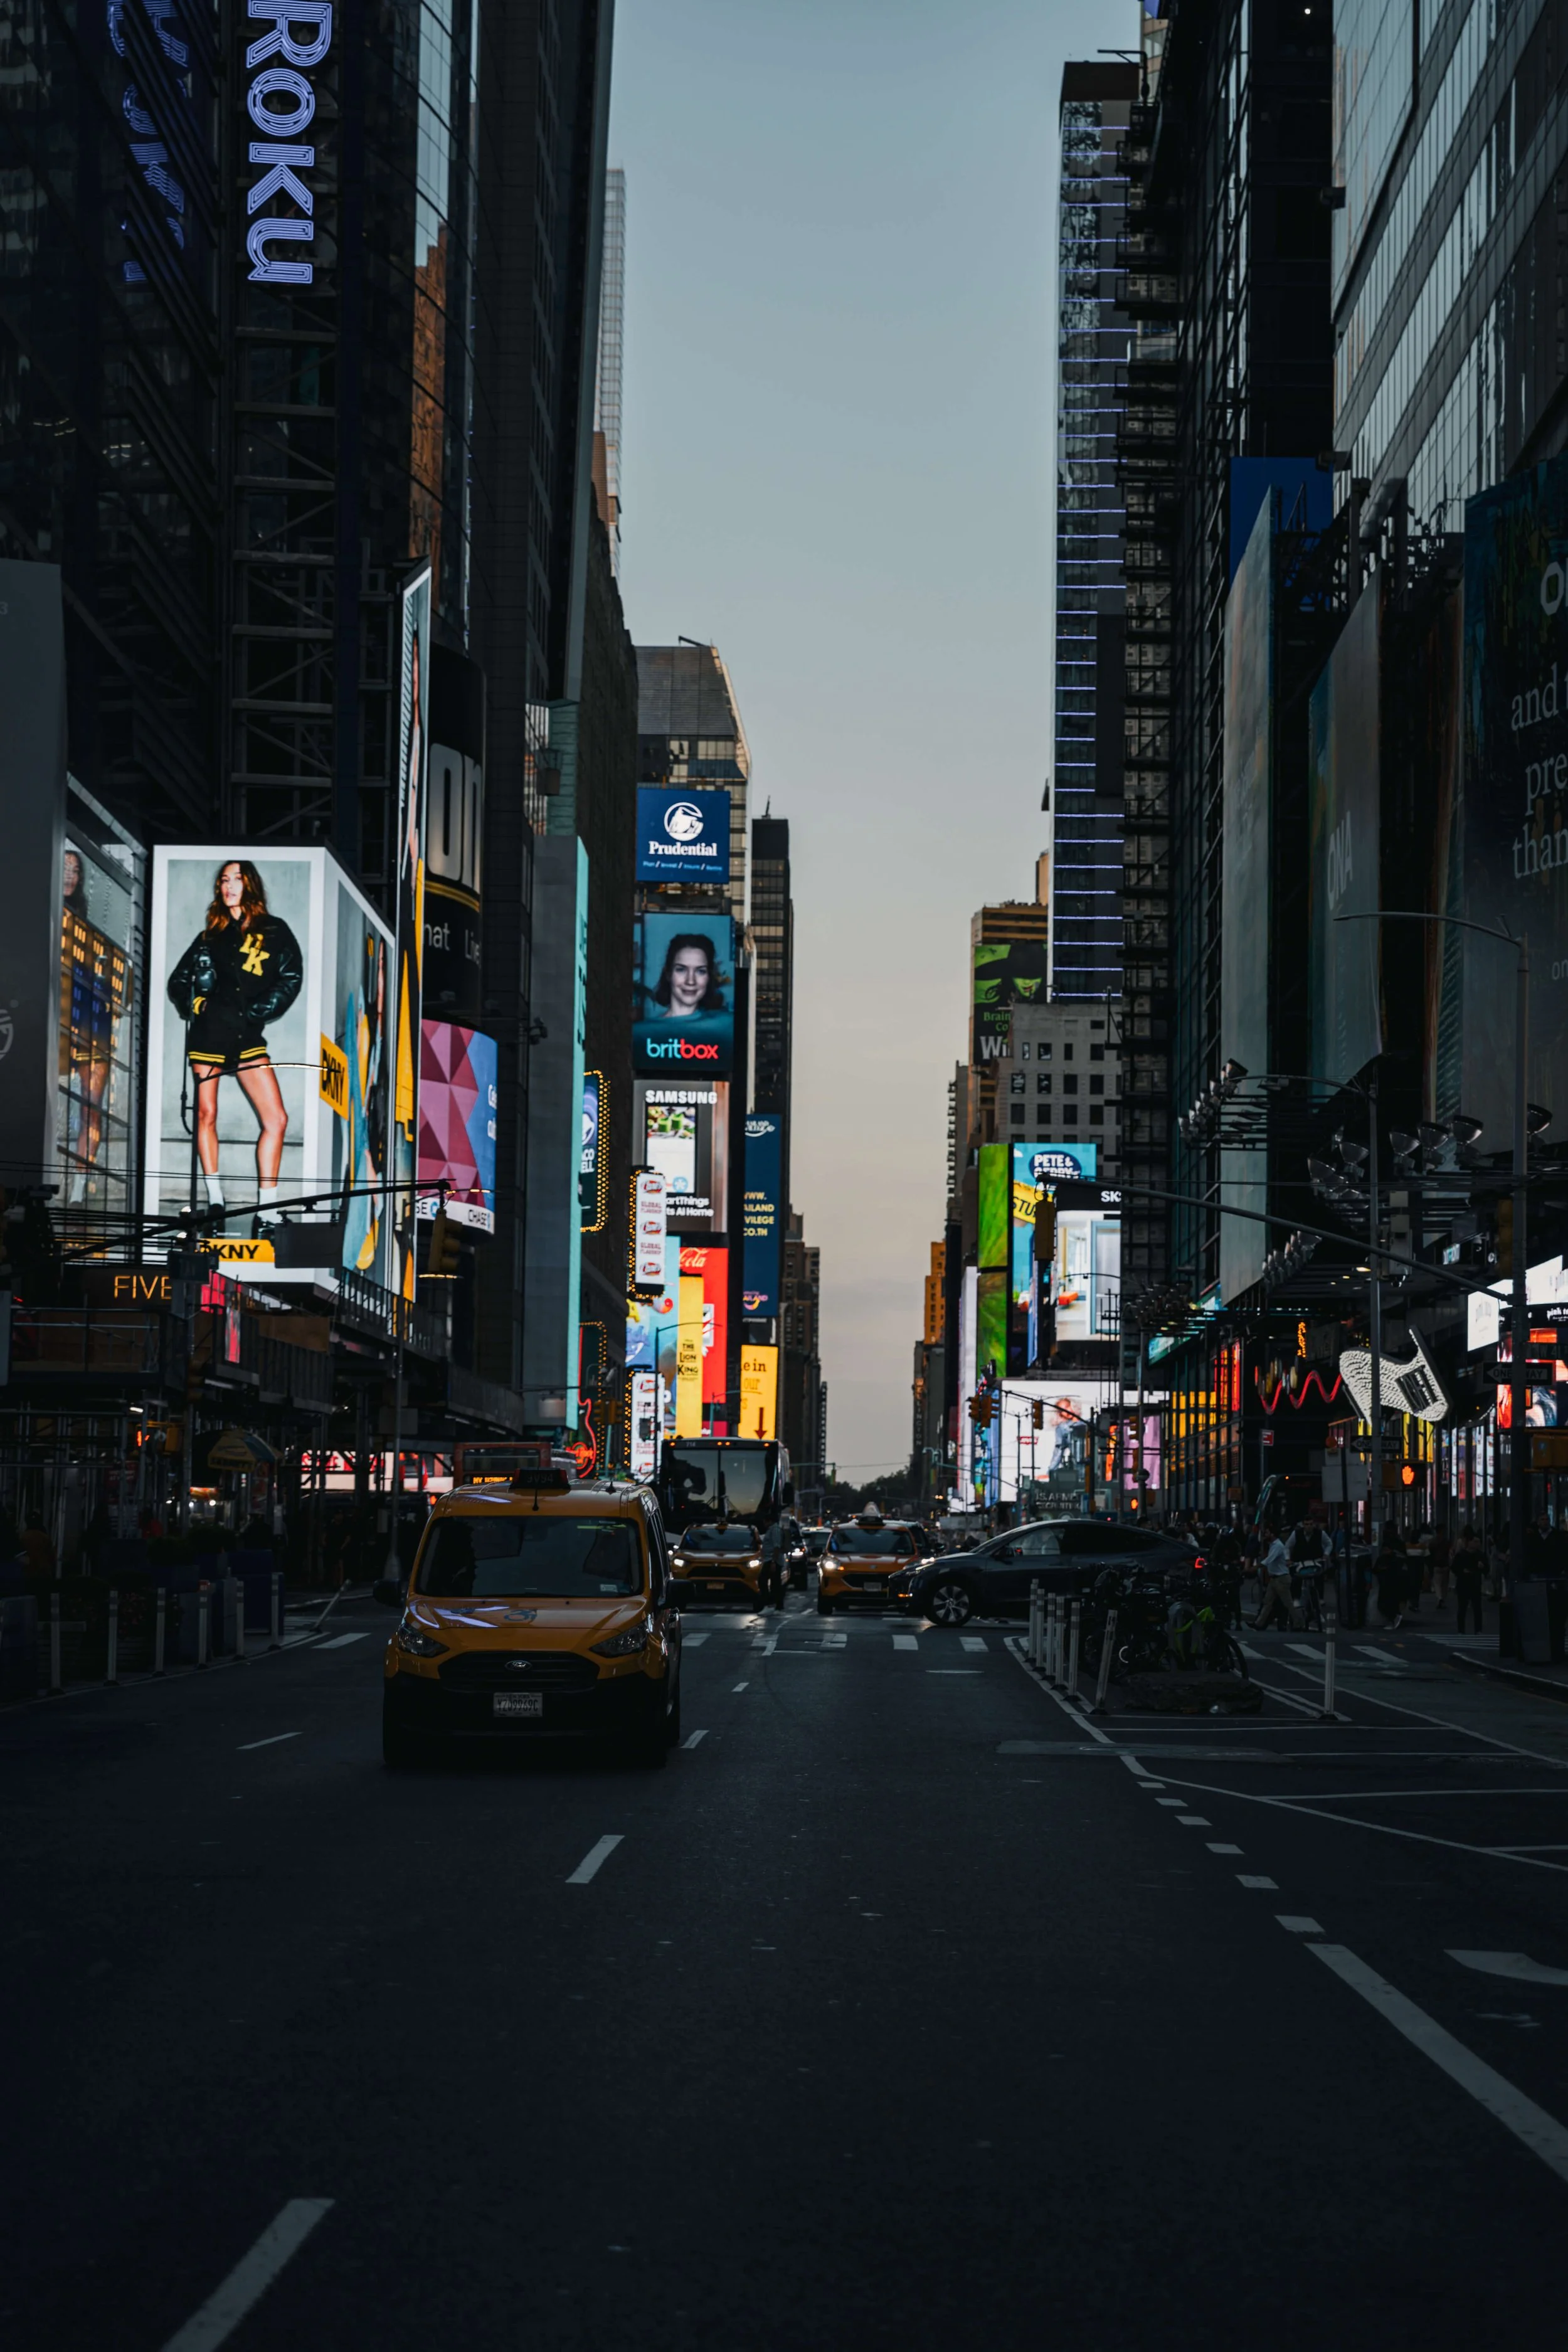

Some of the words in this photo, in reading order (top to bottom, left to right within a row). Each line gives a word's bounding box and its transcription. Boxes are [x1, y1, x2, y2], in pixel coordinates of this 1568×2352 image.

[246, 0, 332, 283] ROKU
[1511, 661, 1559, 731] and
[649, 840, 718, 857] Prudential
[647, 1038, 719, 1059] britbox
[980, 1036, 1010, 1059] Wi
[320, 1047, 345, 1106] DKNY
[645, 1090, 718, 1104] SAMSUNG
[1034, 1154, 1064, 1167] PETE
[1065, 1156, 1074, 1167] &
[686, 1207, 714, 1217] Home
[114, 1275, 172, 1300] FIVE
[753, 1358, 766, 1372] in
[1493, 1369, 1512, 1378] ONE
